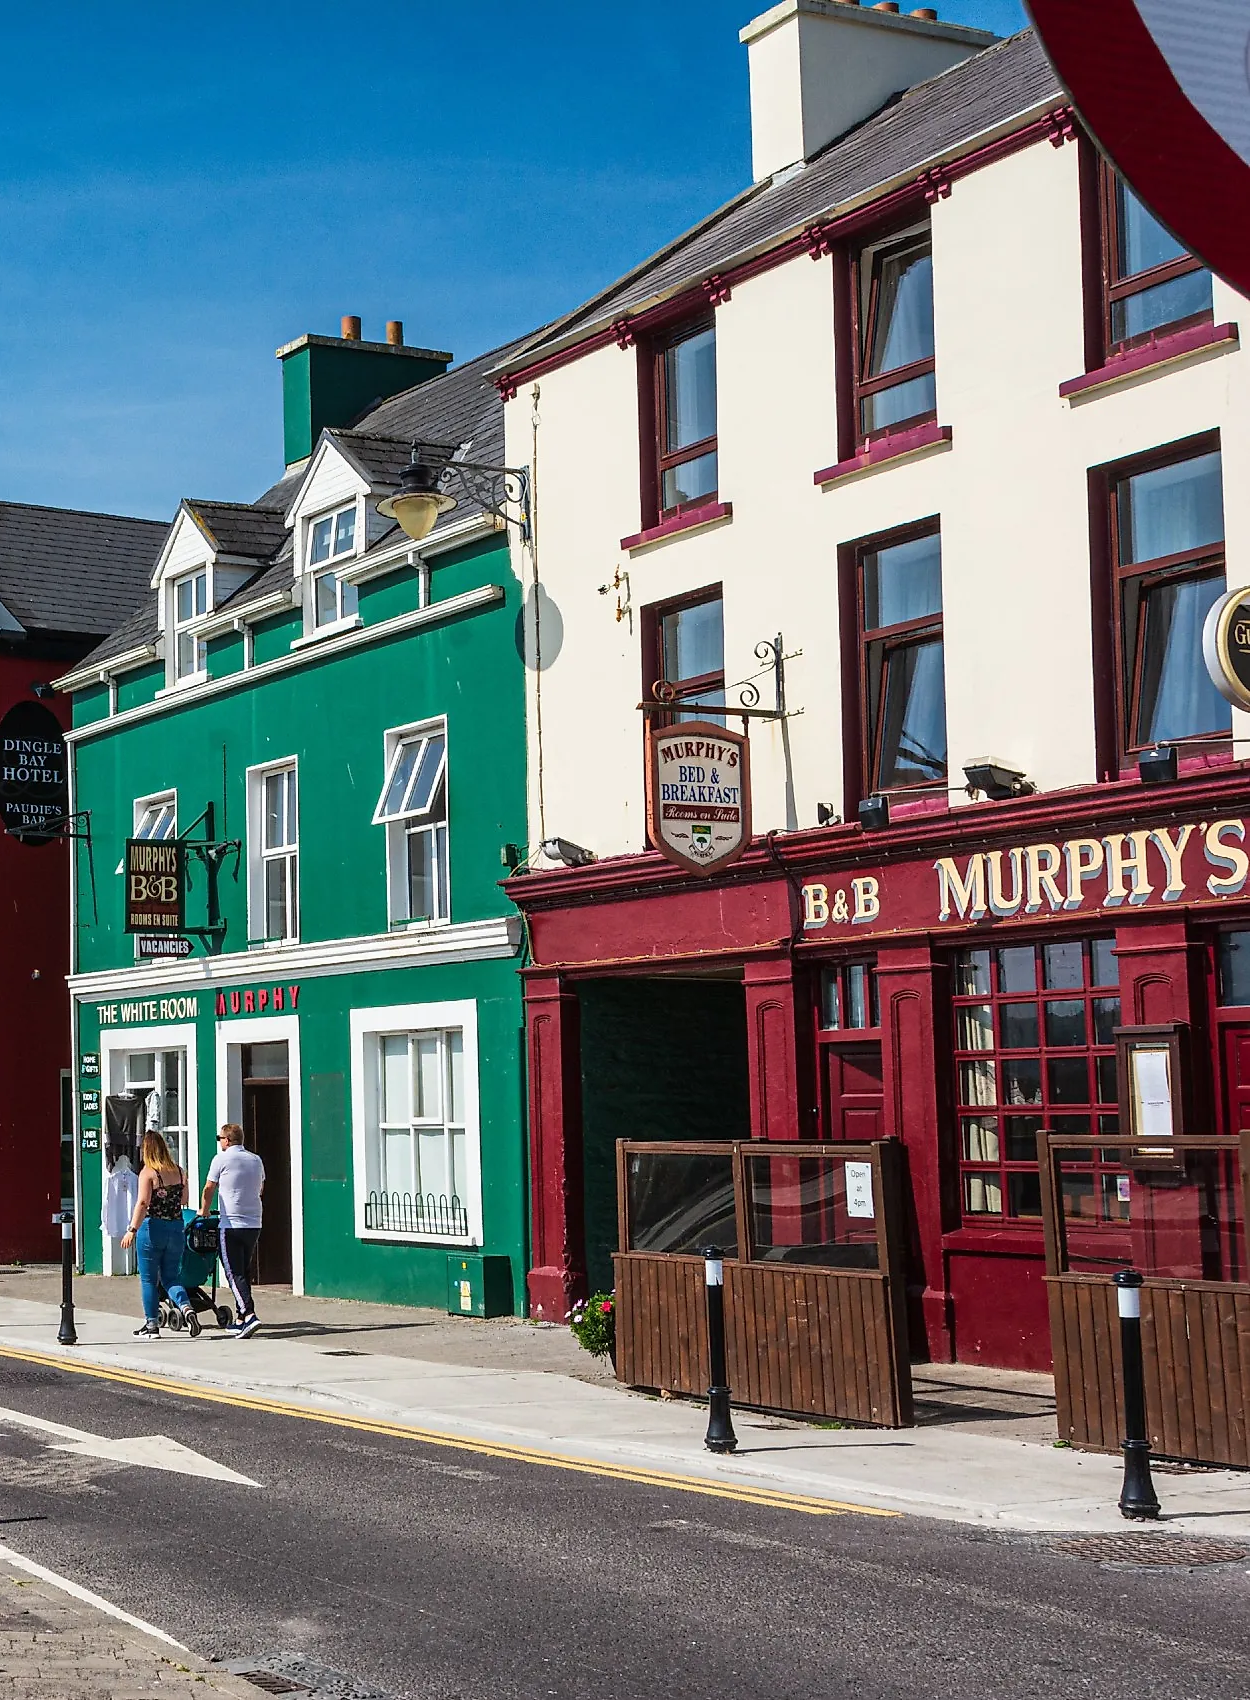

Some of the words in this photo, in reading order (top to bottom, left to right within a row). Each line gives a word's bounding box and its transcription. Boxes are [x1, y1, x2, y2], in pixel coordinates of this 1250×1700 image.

[3, 739, 62, 754] DINGLE
[18, 754, 47, 767] BAY
[661, 741, 739, 768] MURPHY'S
[2, 766, 64, 784] HOTEL
[678, 765, 706, 783] BED
[710, 767, 720, 784] &
[661, 783, 739, 804] BREAKFAST
[5, 802, 62, 815] PAUDIE'S
[665, 806, 698, 819] Rooms
[699, 811, 711, 820] en
[713, 807, 738, 821] Suite
[130, 845, 177, 873] MURPHYS
[802, 876, 881, 929] B&B
[933, 819, 1250, 922] MURPHY'S
[130, 874, 178, 902] B&B
[130, 913, 152, 926] ROOMS
[153, 913, 161, 926] EN
[161, 914, 179, 927] SUITE
[140, 940, 189, 954] VACANCIES
[97, 1004, 118, 1025] THE
[120, 1001, 157, 1023] WHITE
[160, 997, 198, 1020] ROOM
[82, 1055, 96, 1064] HOME
[86, 1065, 98, 1073] GIFTS
[82, 1093, 92, 1101] KIDS
[83, 1102, 98, 1110] LADIES
[850, 1169, 865, 1178] Open
[853, 1198, 866, 1208] 4pm
